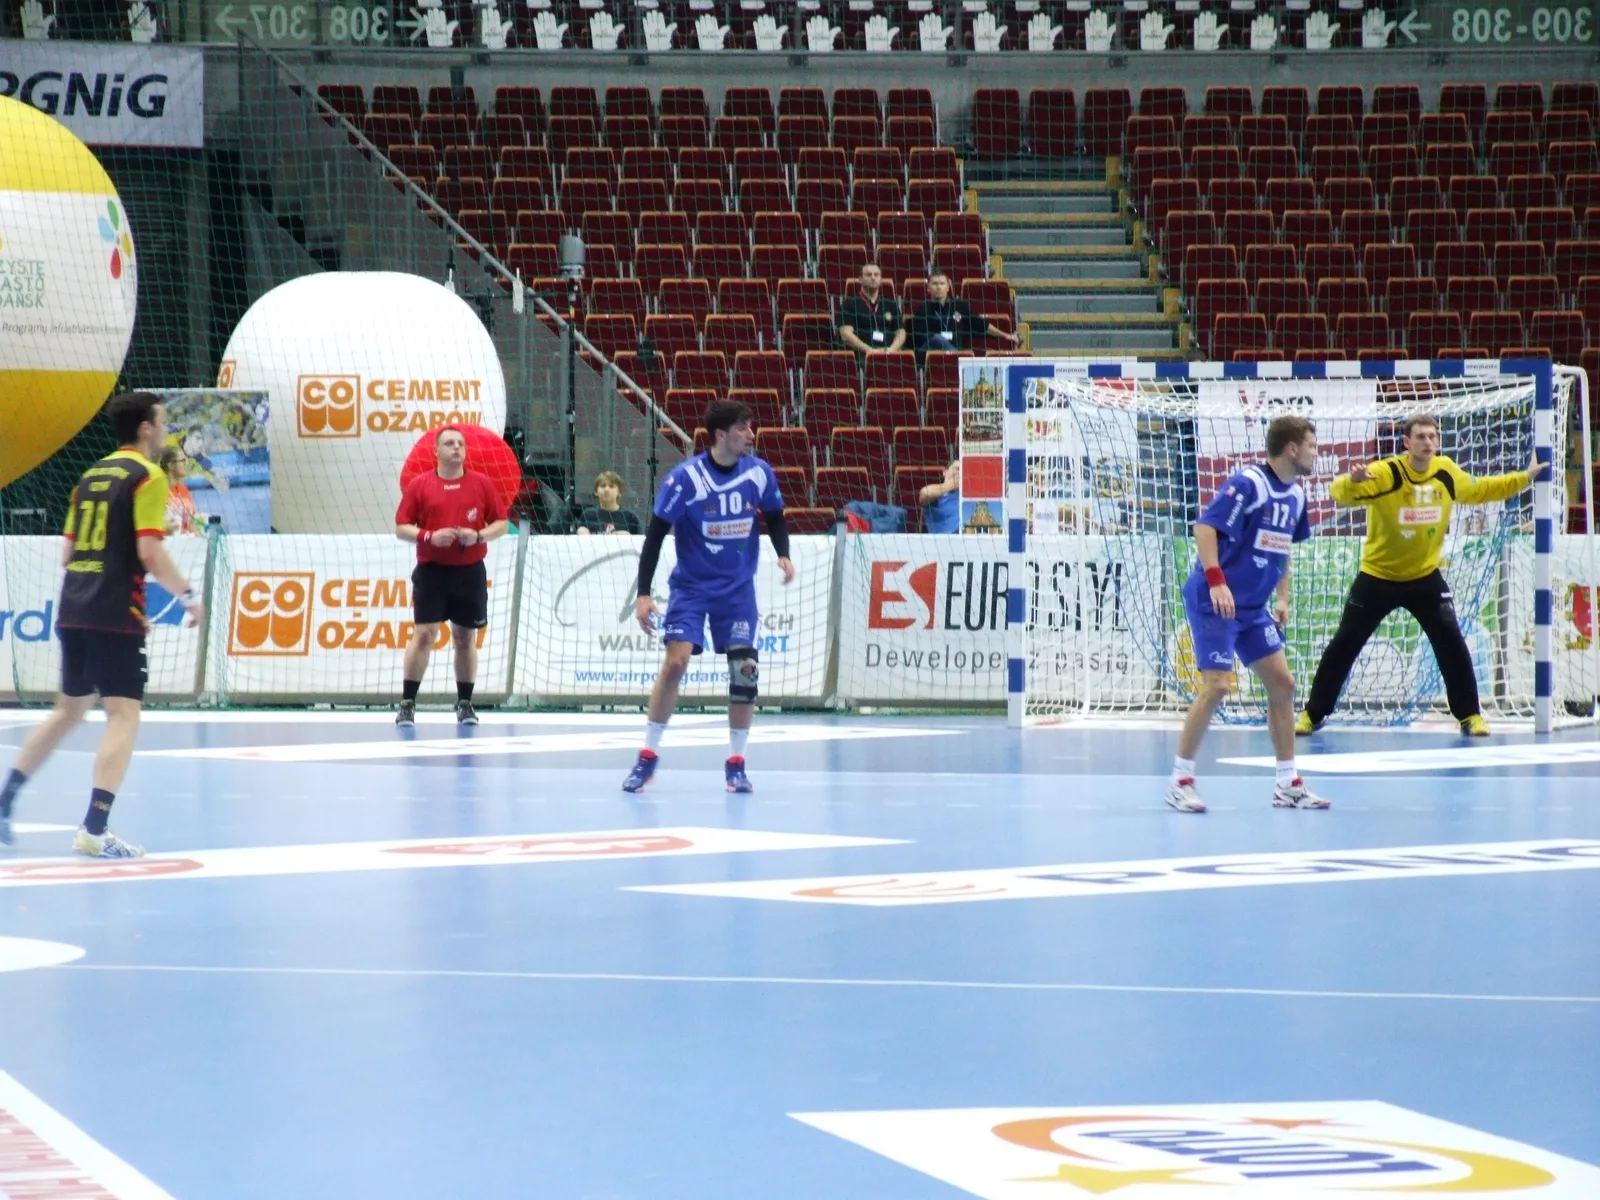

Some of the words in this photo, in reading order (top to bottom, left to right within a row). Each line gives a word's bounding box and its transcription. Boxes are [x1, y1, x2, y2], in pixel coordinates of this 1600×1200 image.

[366, 379, 481, 400] CEMENT
[718, 491, 742, 516] 10
[1271, 503, 1290, 528] 17
[320, 579, 492, 608] CEM
[317, 612, 488, 649] OŻAR
[866, 643, 1010, 674] Dewelope
